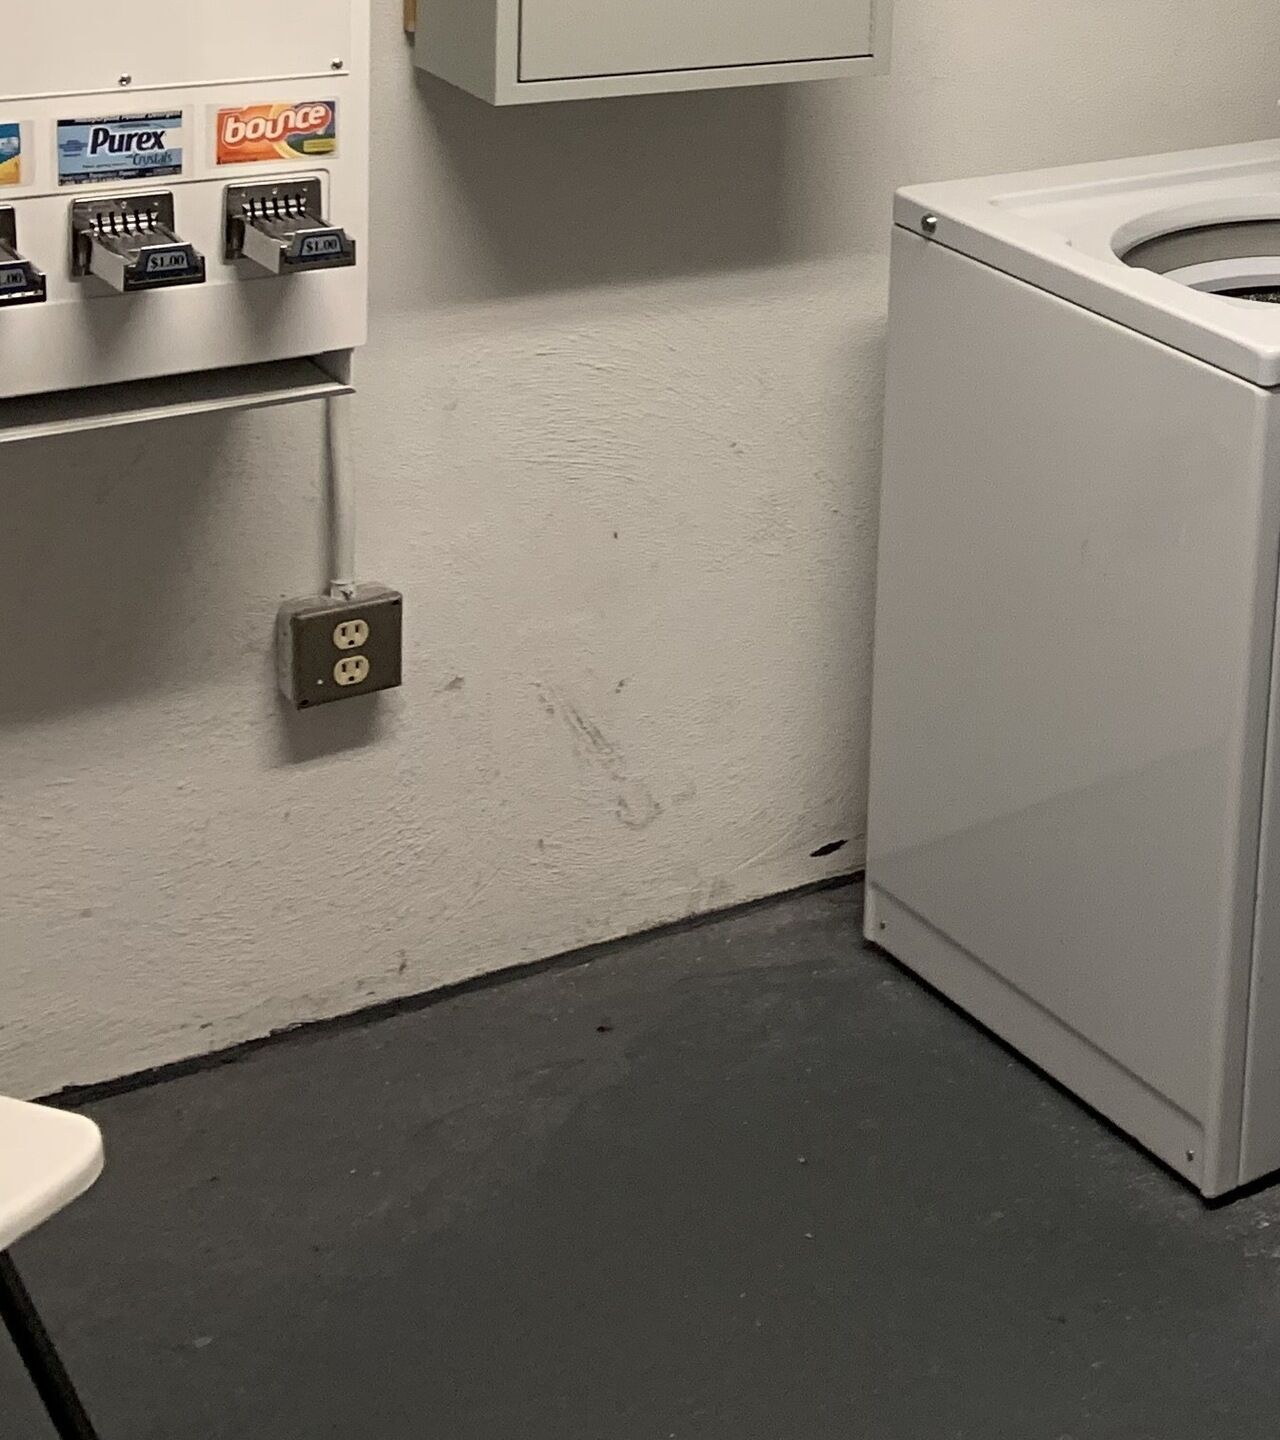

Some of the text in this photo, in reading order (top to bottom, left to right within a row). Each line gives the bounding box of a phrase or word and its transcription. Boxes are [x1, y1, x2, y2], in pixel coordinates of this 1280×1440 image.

[224, 105, 326, 145] bounce
[90, 127, 166, 155] Purex
[305, 239, 338, 254] $1.00
[150, 254, 184, 269] $1.00
